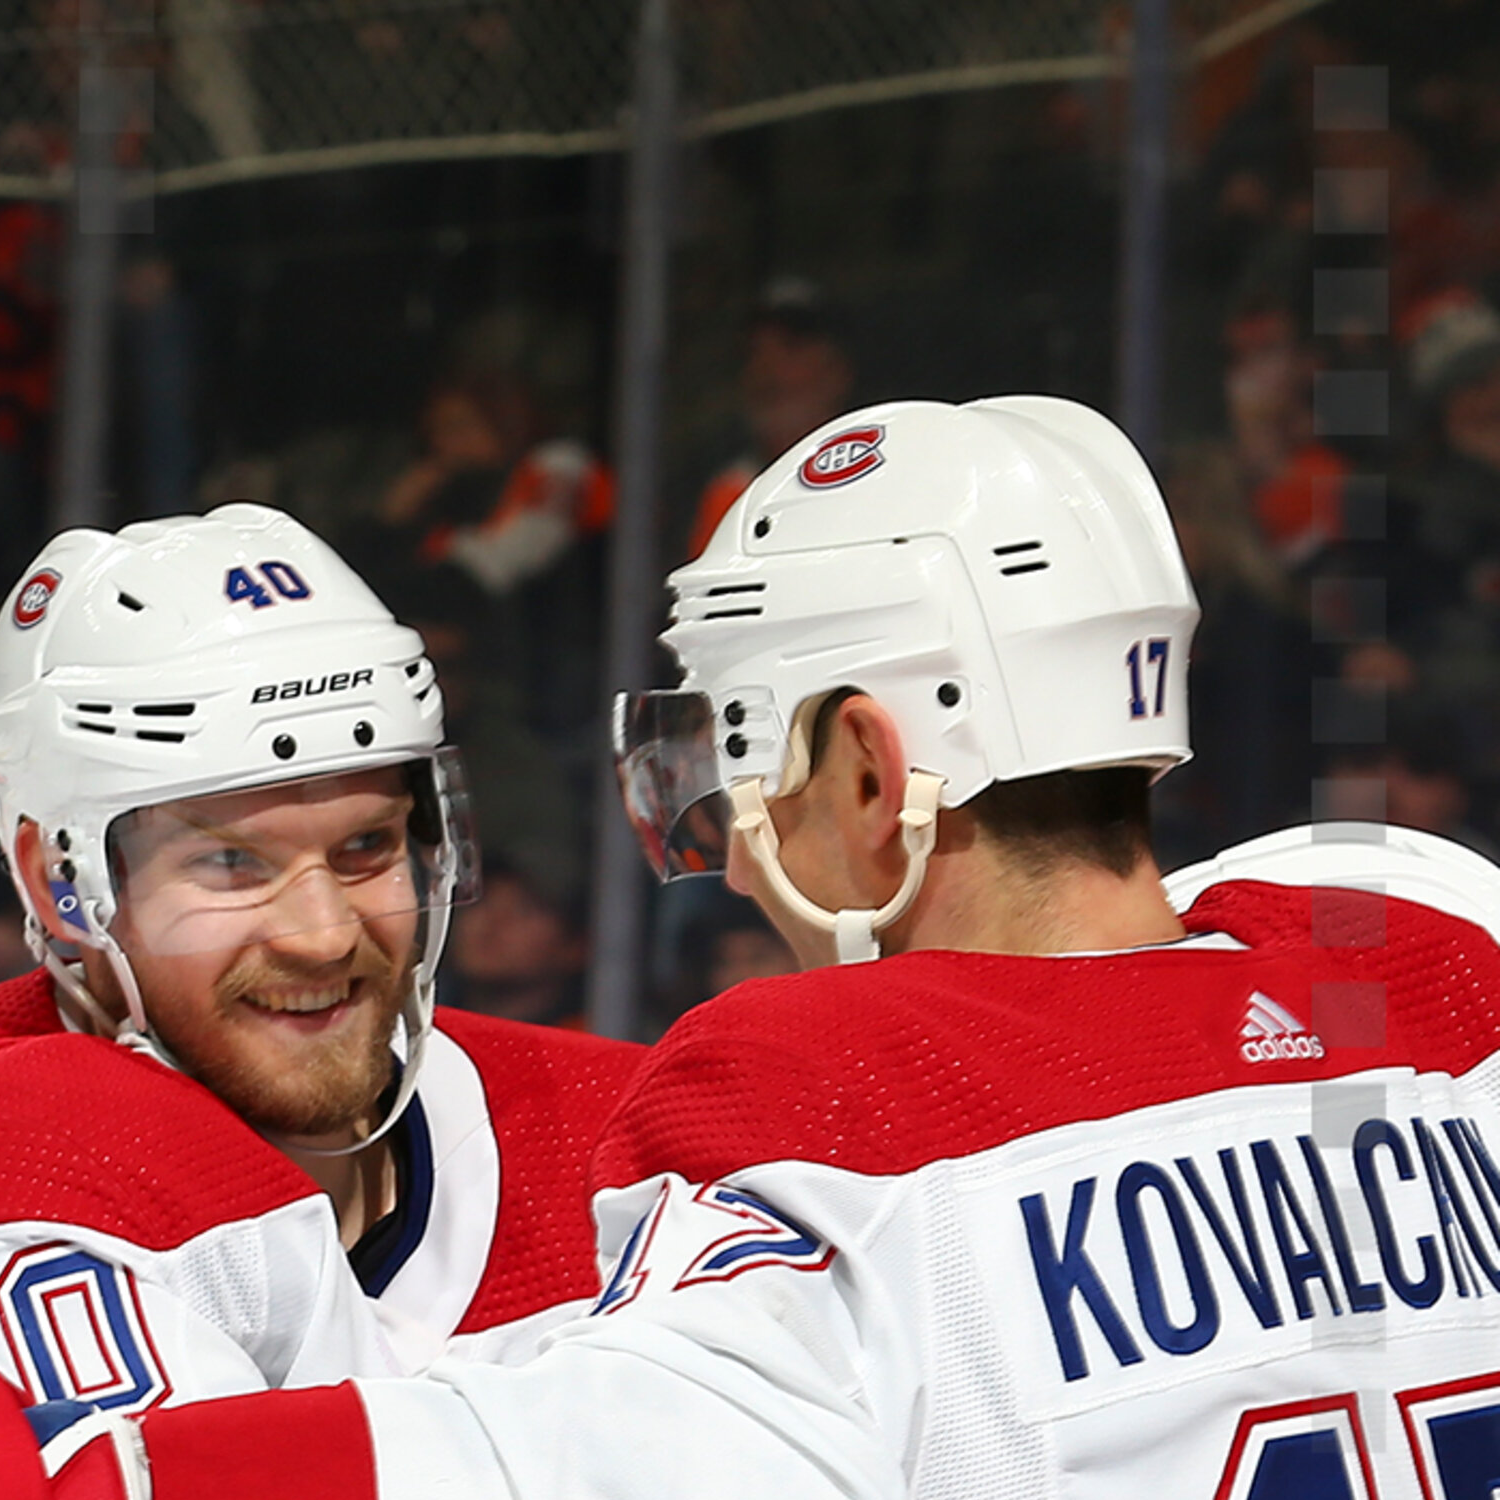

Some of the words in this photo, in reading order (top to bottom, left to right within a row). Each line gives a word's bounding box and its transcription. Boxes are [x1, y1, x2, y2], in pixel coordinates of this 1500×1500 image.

[224, 561, 314, 610] 40
[1125, 636, 1172, 721] 17
[1241, 1034, 1325, 1063] adidas
